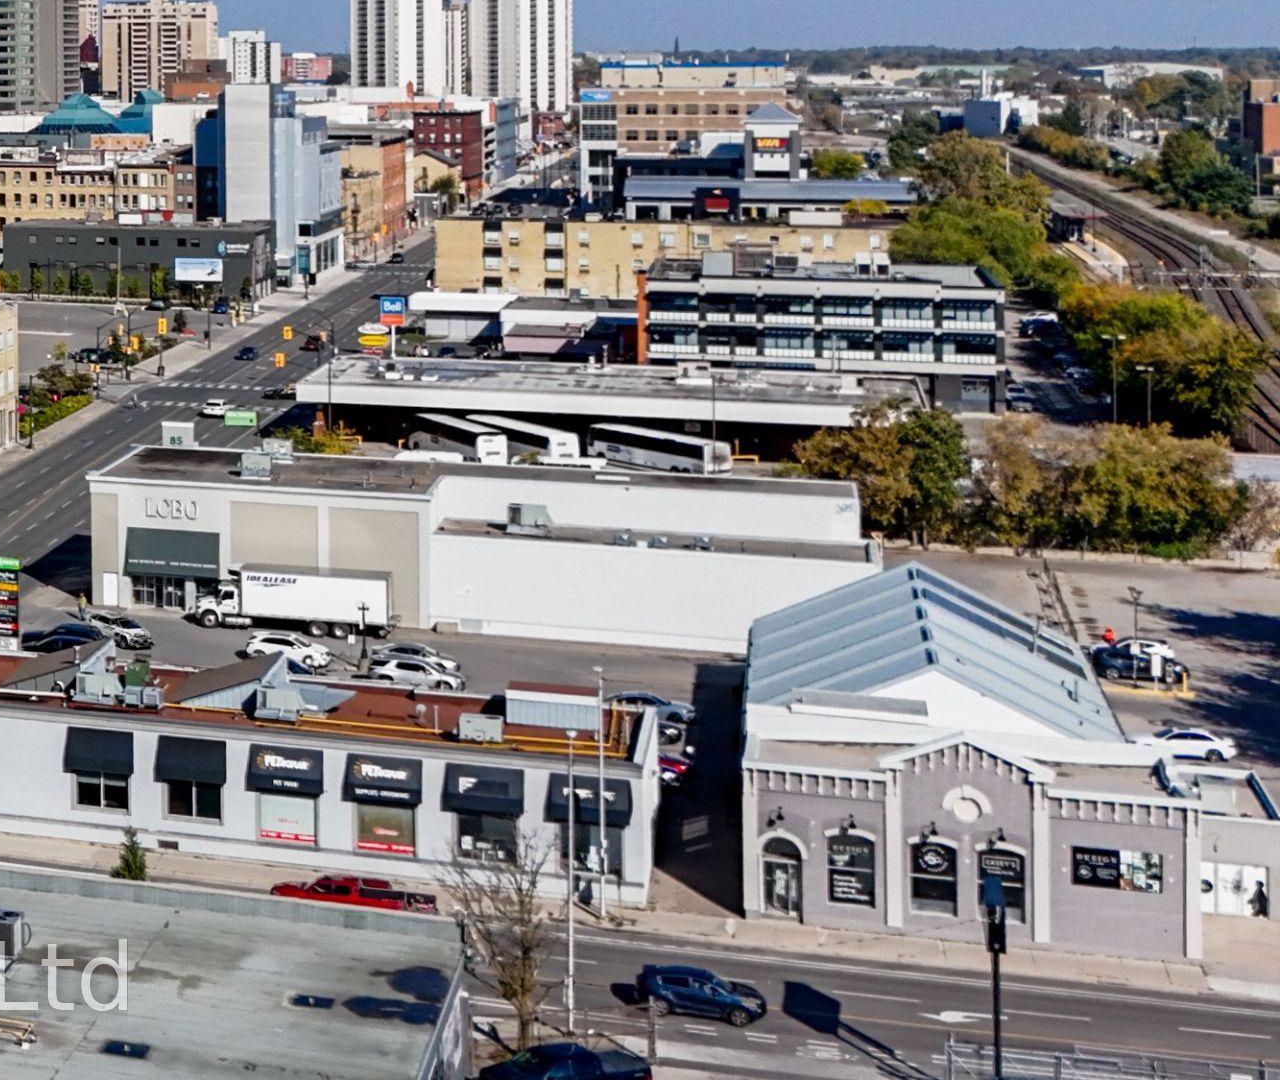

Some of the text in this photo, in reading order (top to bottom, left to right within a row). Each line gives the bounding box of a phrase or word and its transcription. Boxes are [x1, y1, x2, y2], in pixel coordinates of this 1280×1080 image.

[383, 301, 402, 311] Bell
[170, 436, 183, 445] 85
[145, 498, 199, 520] LCBO
[246, 575, 298, 584] IDEALEASE
[1076, 853, 1118, 864] DESIGN
